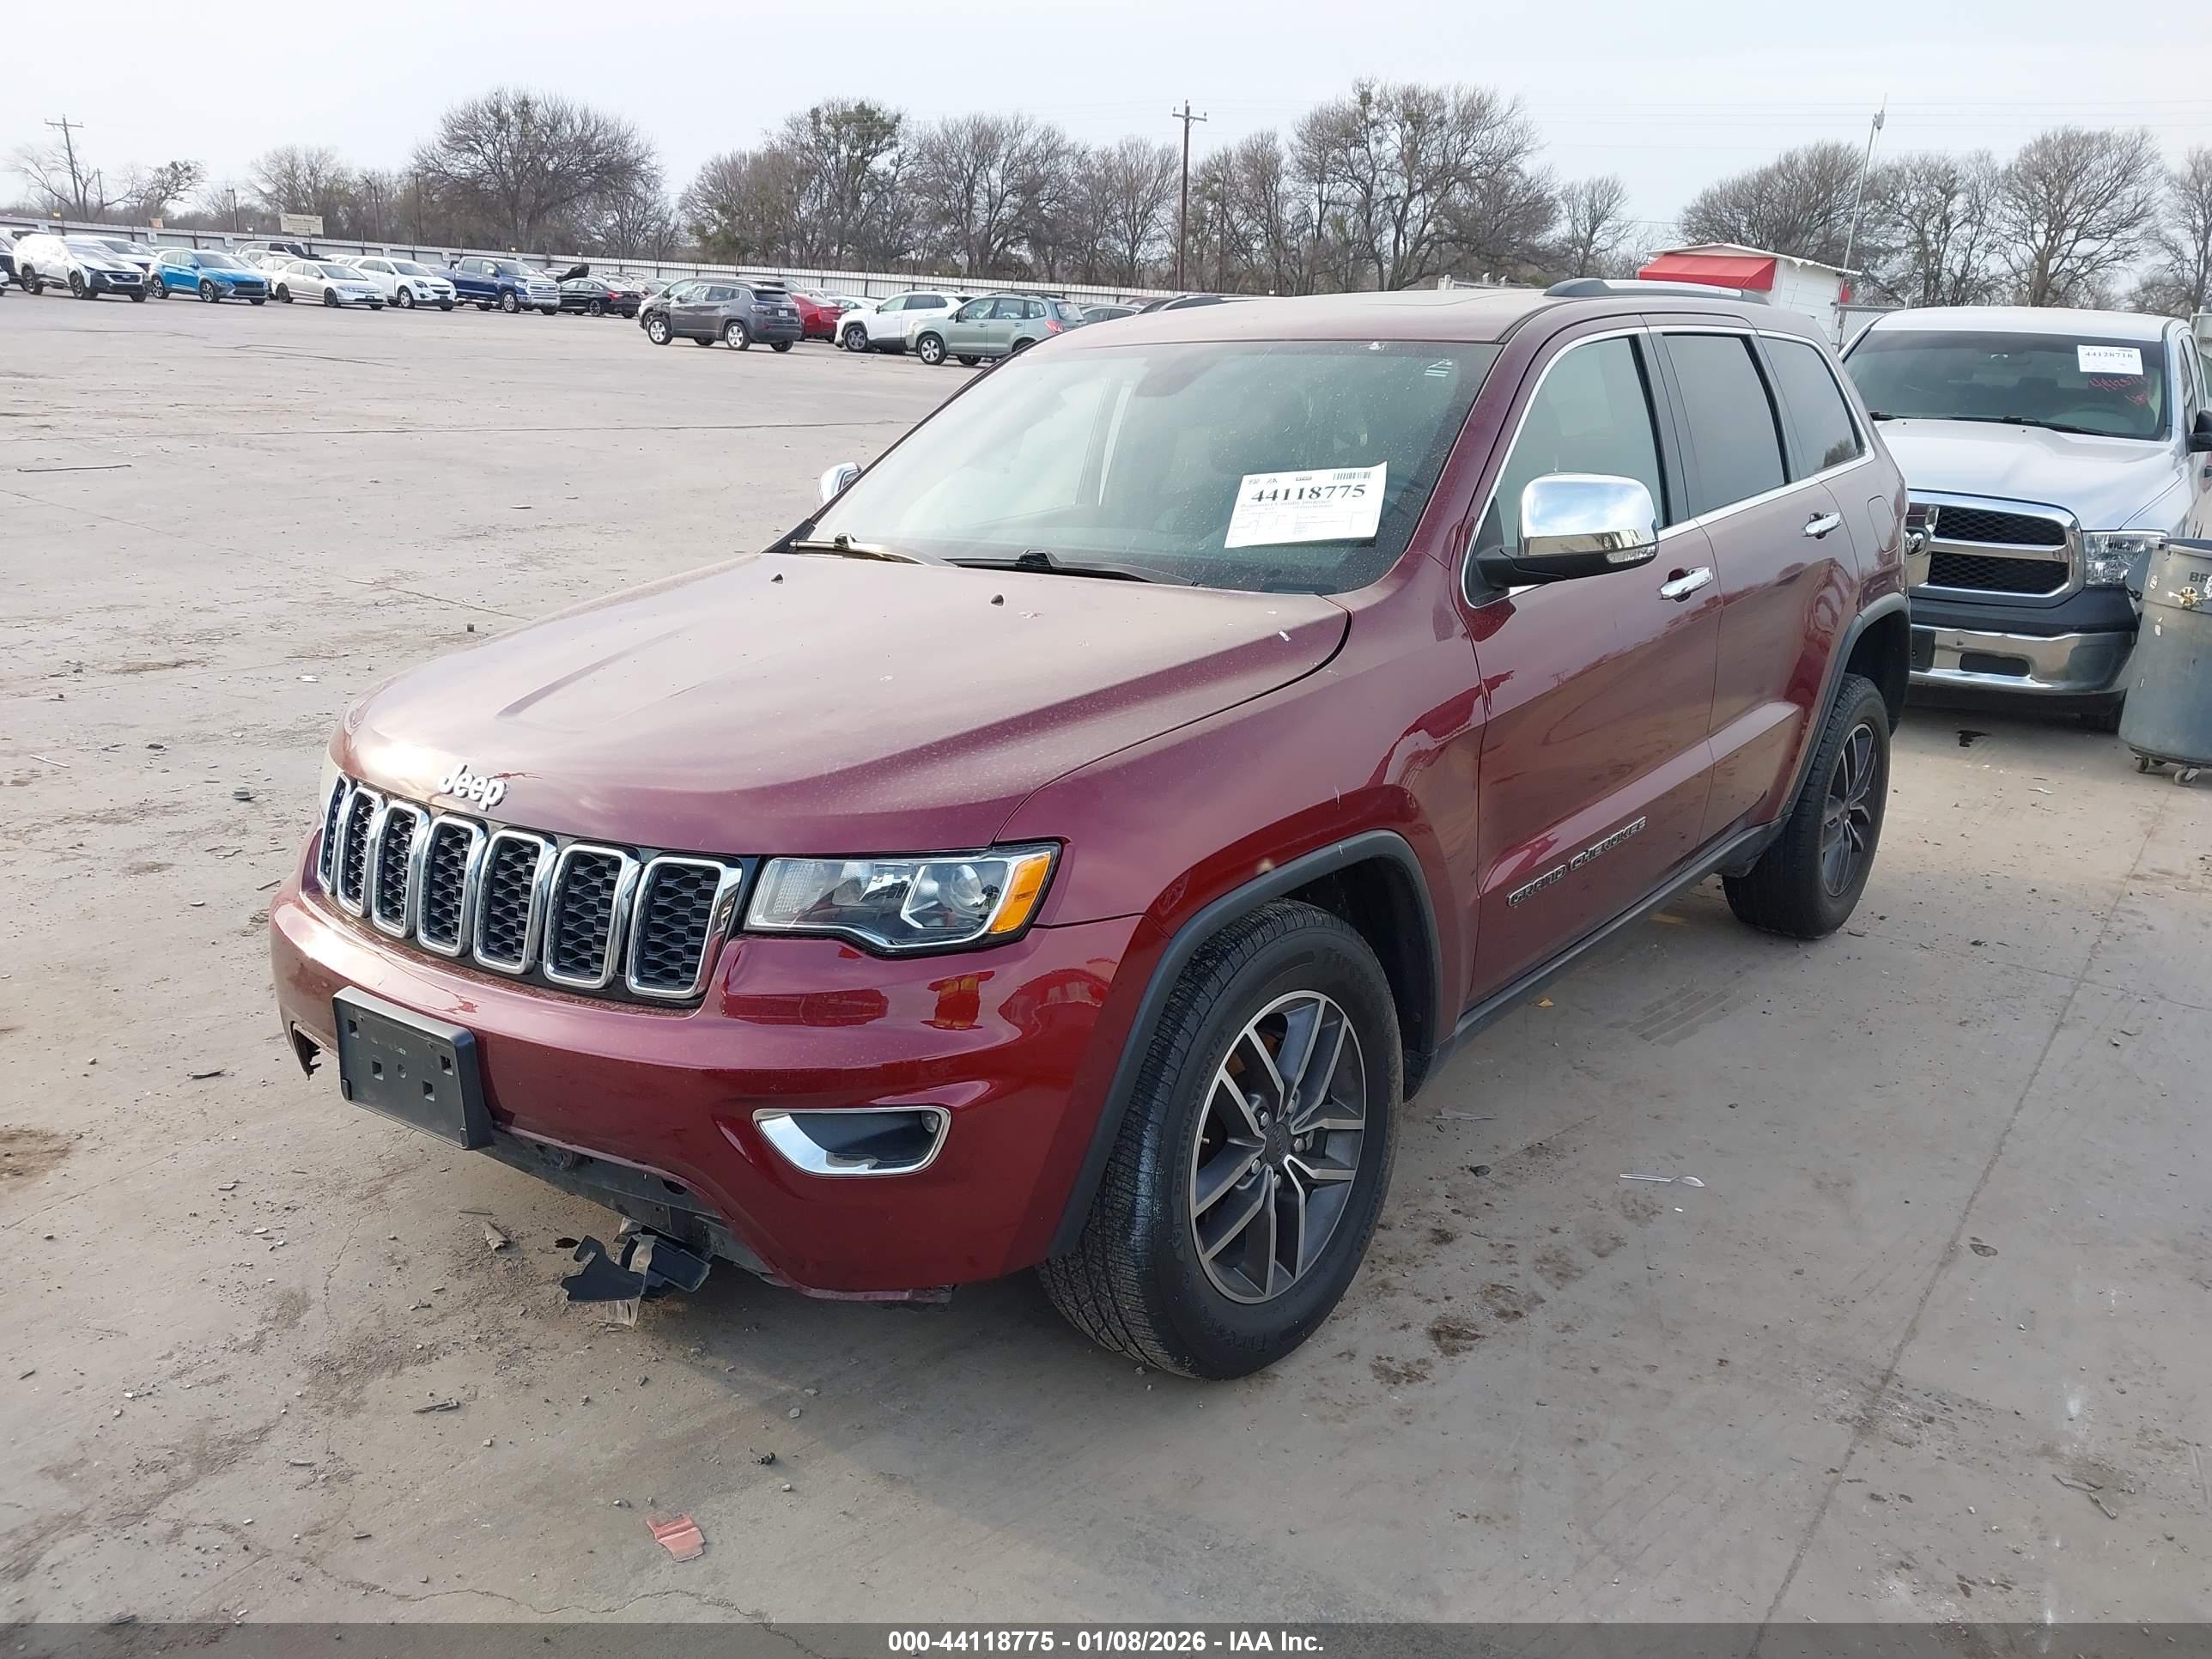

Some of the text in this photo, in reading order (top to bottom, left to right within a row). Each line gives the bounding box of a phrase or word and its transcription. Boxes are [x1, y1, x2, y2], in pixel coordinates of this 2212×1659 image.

[1251, 483, 1367, 502] 44118775
[439, 763, 507, 811] Jeep
[1508, 816, 1647, 907] GRAND CHEROKEE
